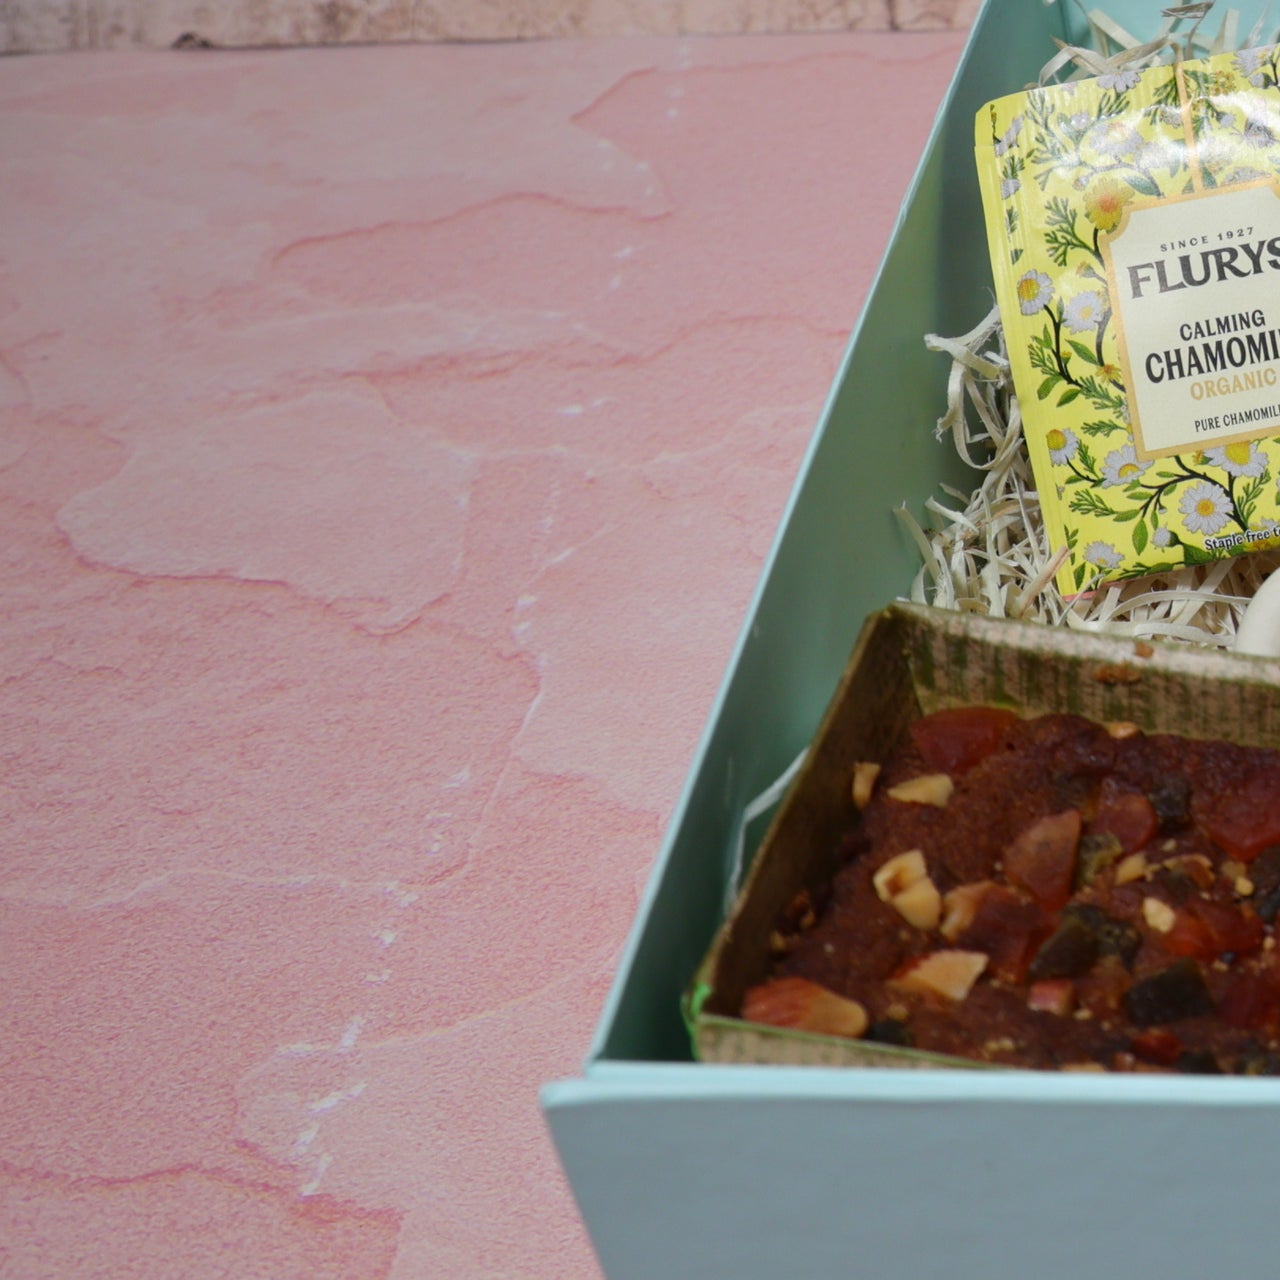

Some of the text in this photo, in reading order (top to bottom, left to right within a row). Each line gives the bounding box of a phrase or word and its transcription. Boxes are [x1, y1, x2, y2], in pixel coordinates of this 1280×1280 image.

[1160, 226, 1254, 252] SINCE 1927
[1179, 309, 1266, 341] CALMING
[1190, 368, 1277, 401] ORGANIC
[1194, 416, 1221, 433] PURE
[1204, 533, 1244, 551] Staple
[1245, 529, 1271, 543] free
